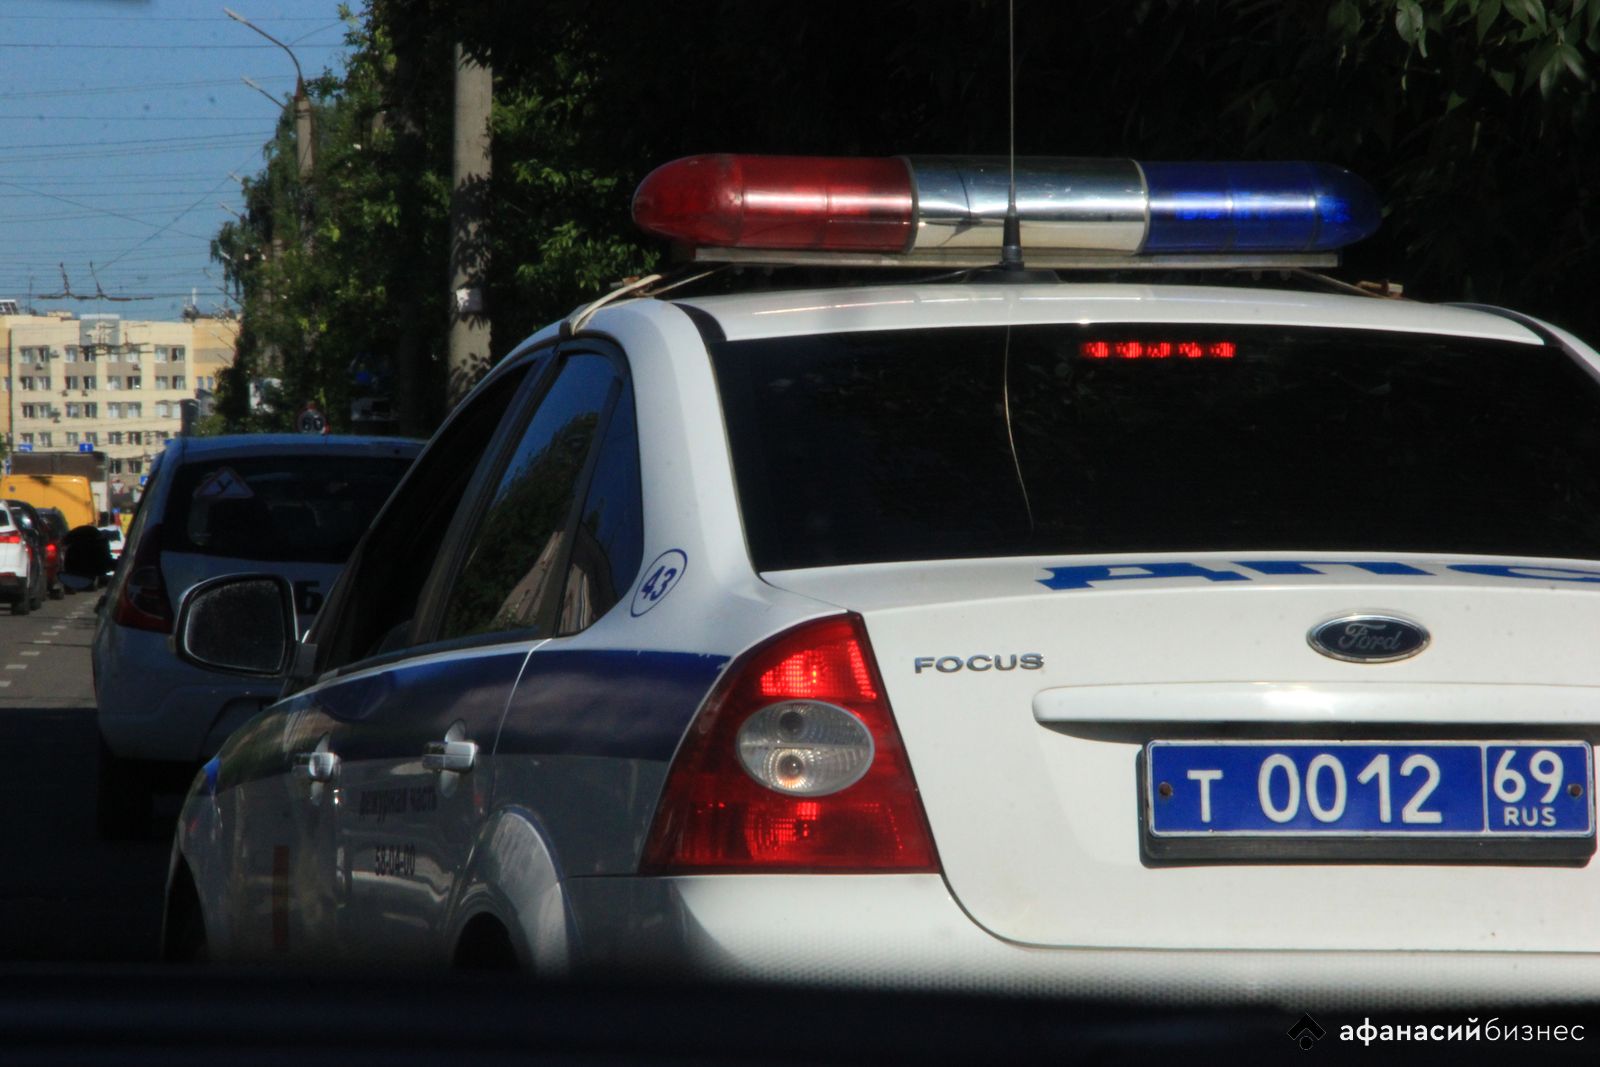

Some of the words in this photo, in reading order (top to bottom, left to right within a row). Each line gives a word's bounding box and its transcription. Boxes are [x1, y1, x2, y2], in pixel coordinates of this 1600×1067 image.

[640, 565, 678, 602] 43
[1336, 622, 1404, 651] Ford
[914, 653, 1045, 675] FOCUS
[1257, 752, 1443, 824] 0012
[1492, 749, 1564, 804] 69
[1504, 806, 1557, 827] RUS
